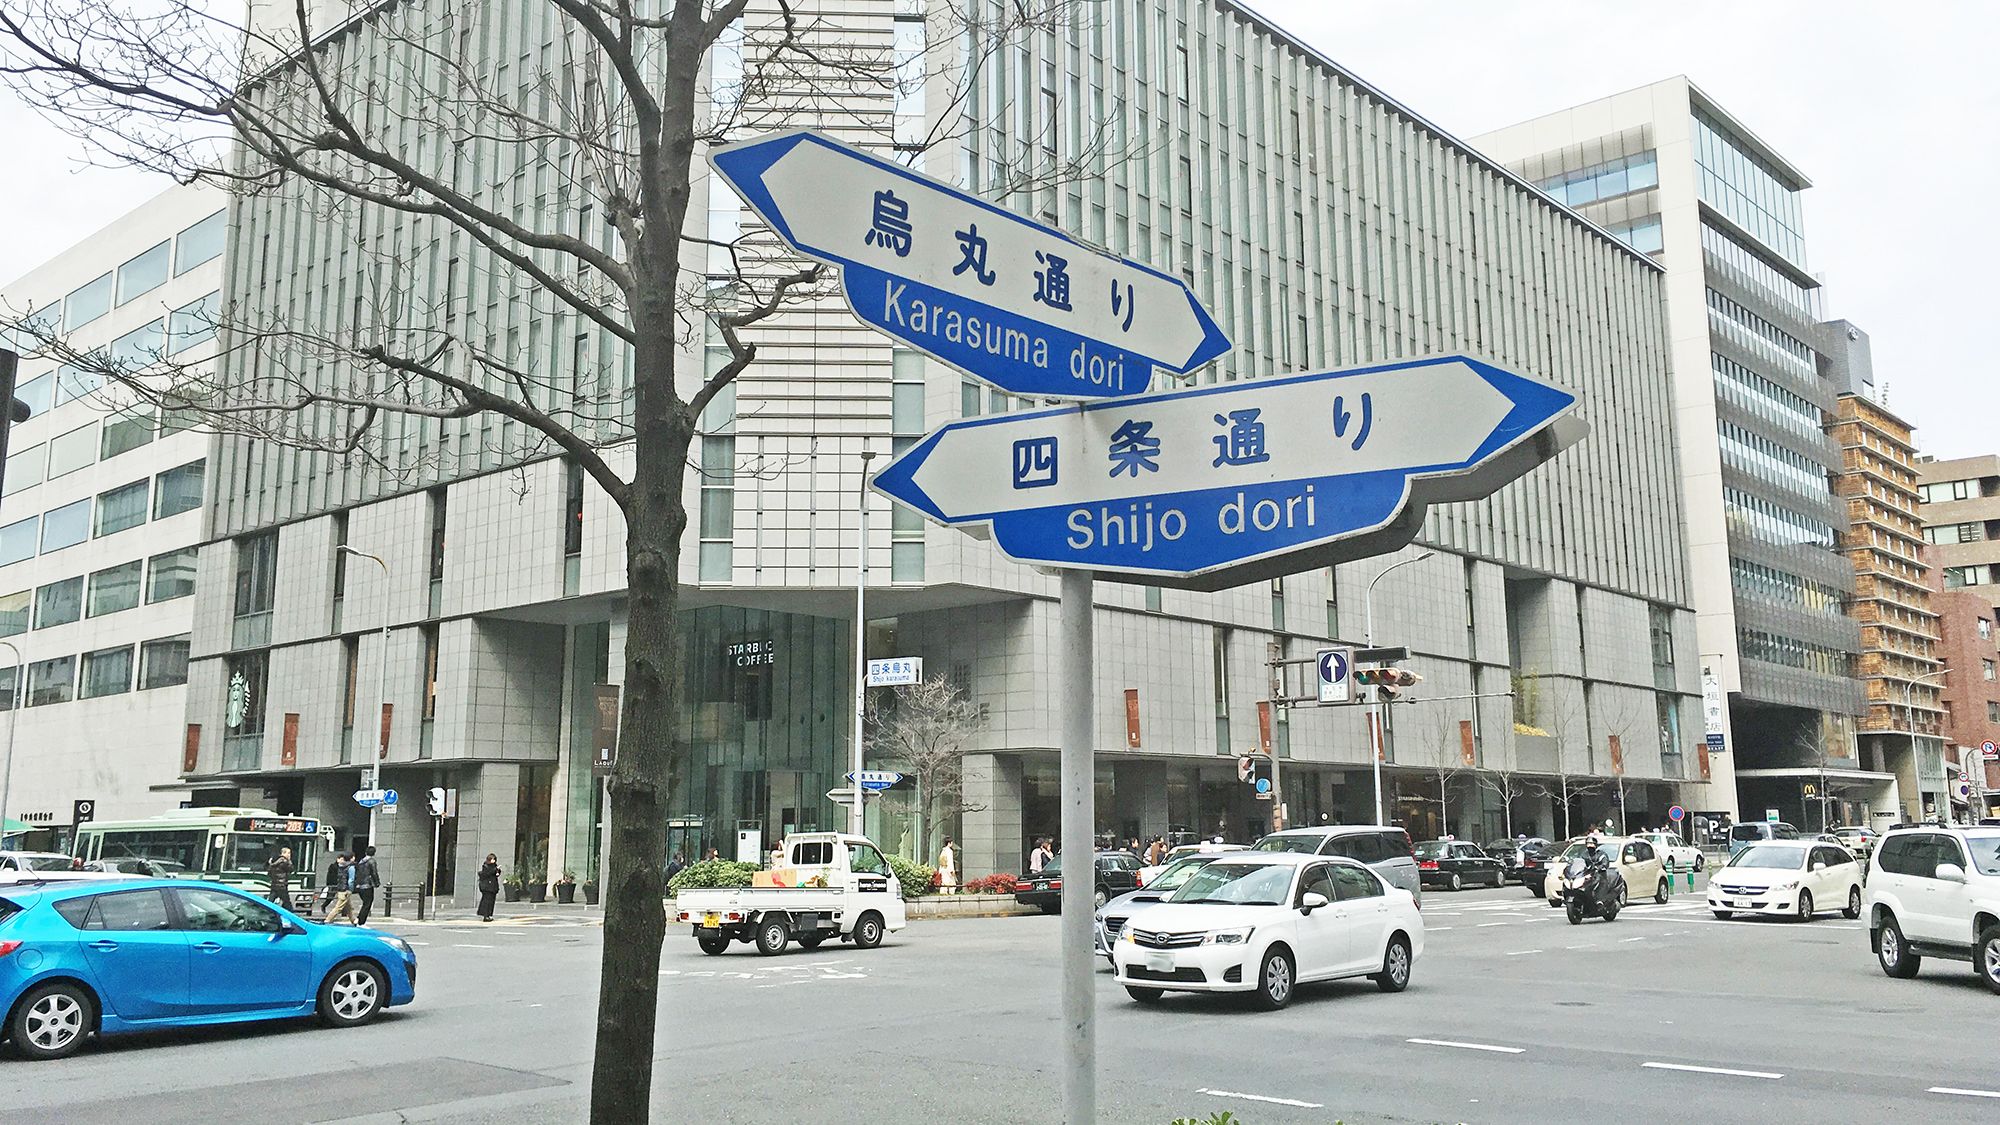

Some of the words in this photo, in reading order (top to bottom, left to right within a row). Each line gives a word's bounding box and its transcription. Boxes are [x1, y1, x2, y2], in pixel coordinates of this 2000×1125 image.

[864, 189, 1136, 333] 烏丸通り
[884, 279, 1048, 369] Karasuma
[1070, 342, 1124, 391] dori
[1012, 392, 1373, 489] 四条通り
[1066, 502, 1188, 552] Shijo
[1217, 484, 1316, 535] dori
[871, 662, 912, 675] 四条烏丸
